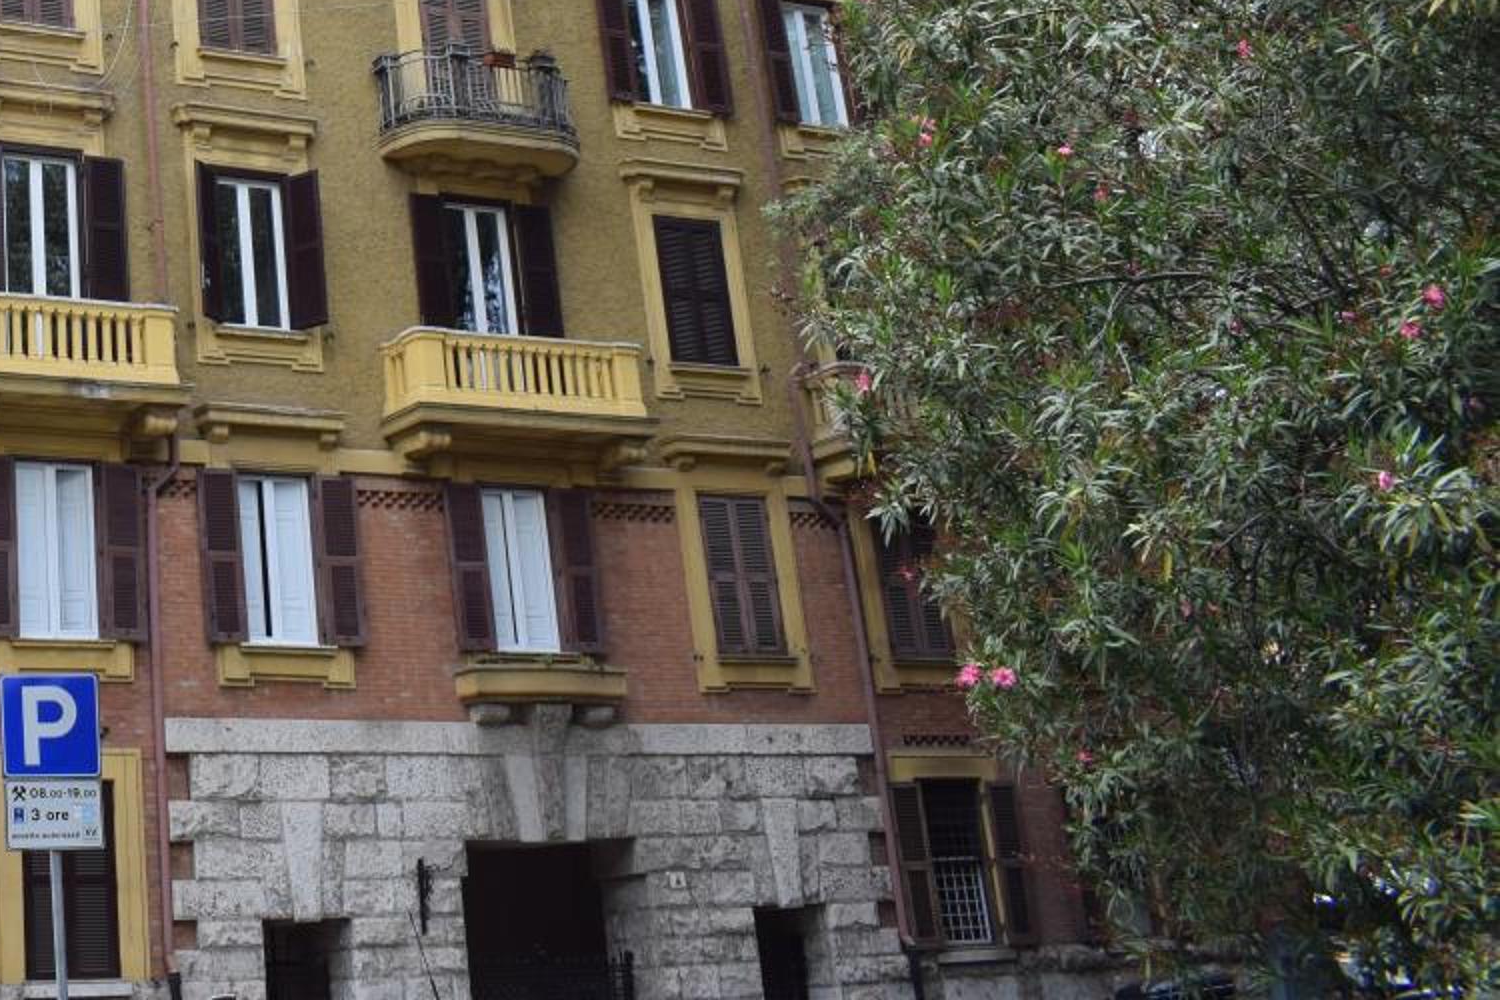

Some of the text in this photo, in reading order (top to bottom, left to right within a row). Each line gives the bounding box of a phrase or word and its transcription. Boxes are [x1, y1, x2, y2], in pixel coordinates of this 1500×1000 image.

[22, 685, 77, 766] P
[30, 787, 97, 799] 08.00-19.00
[31, 808, 69, 821] 3 ore
